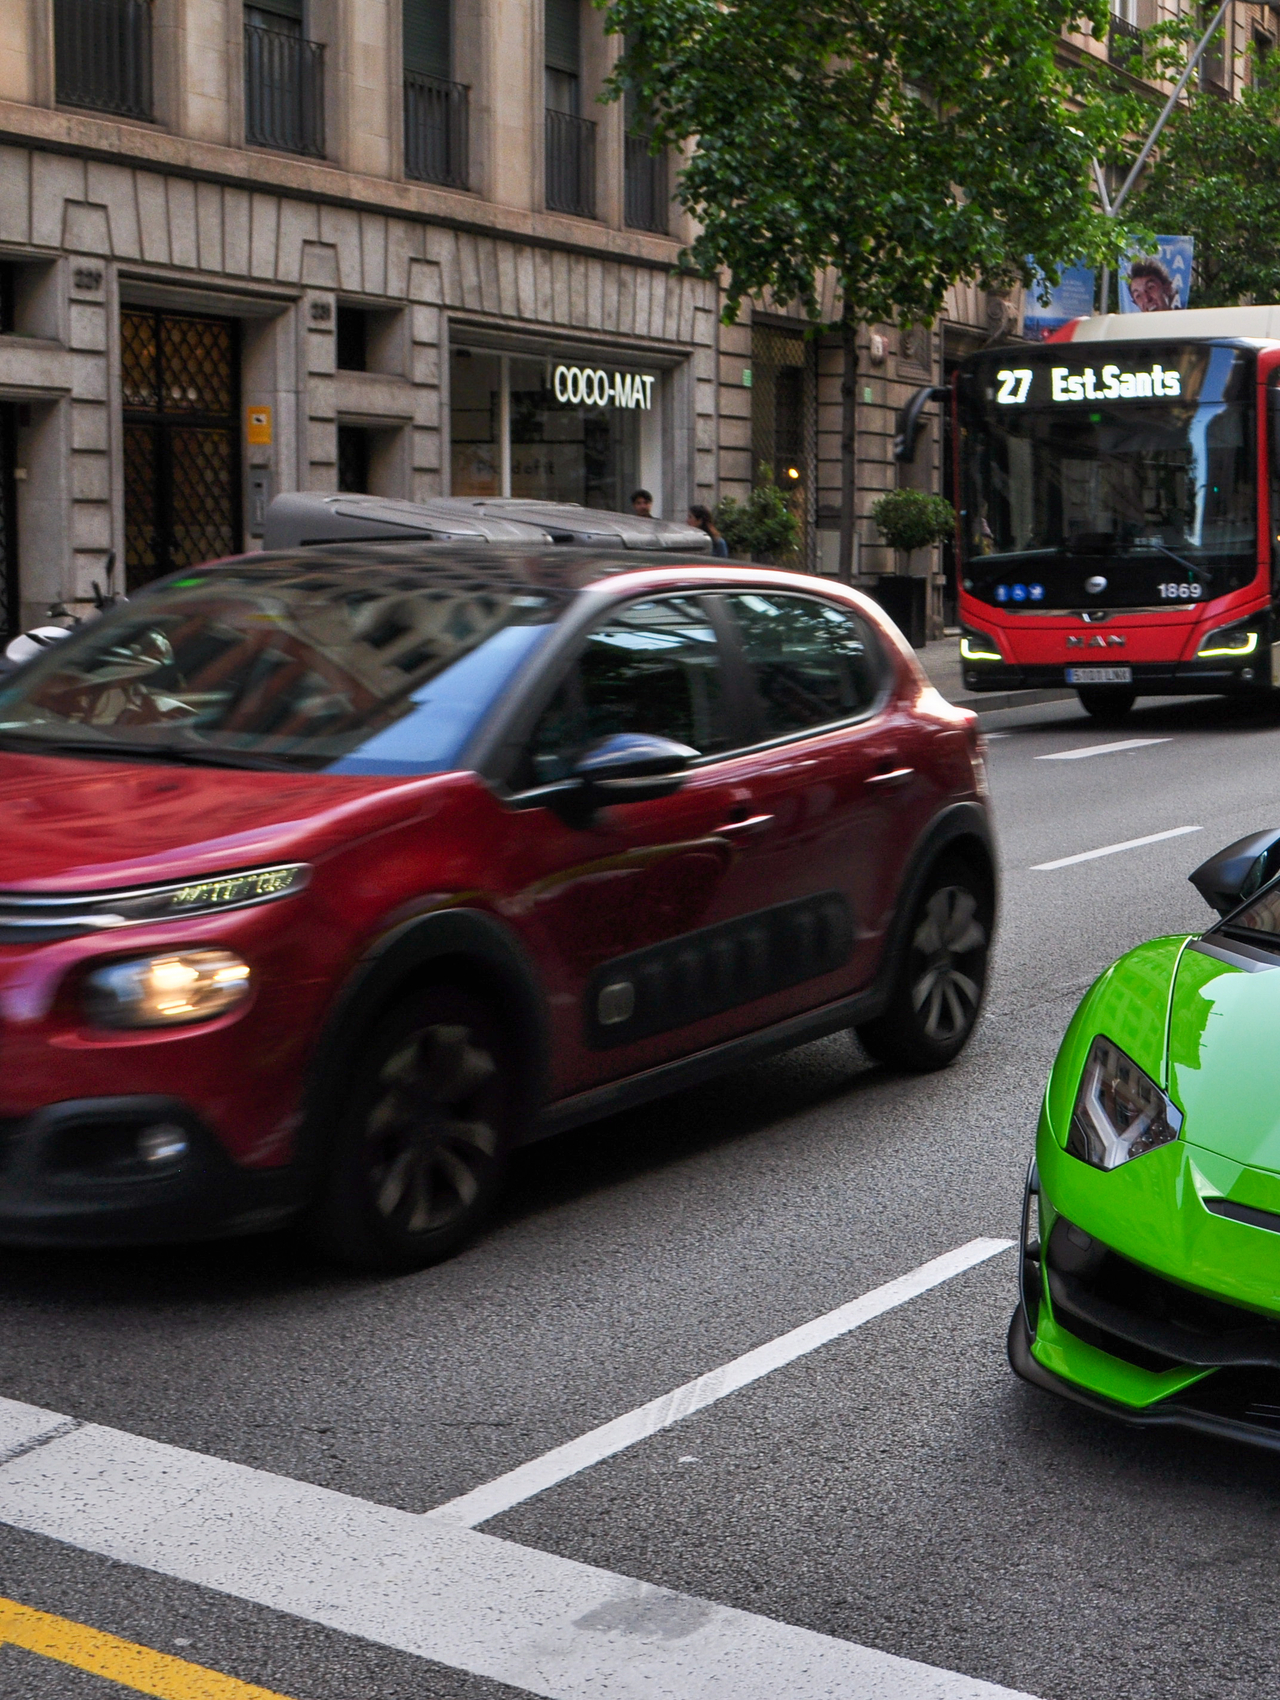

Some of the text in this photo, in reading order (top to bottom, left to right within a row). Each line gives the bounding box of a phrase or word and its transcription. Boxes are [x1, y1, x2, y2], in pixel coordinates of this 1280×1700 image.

[554, 365, 655, 410] COCO-MAT
[996, 364, 1181, 404] 27 Est.Sants
[1157, 583, 1202, 598] 1869
[1066, 634, 1127, 648] MAN
